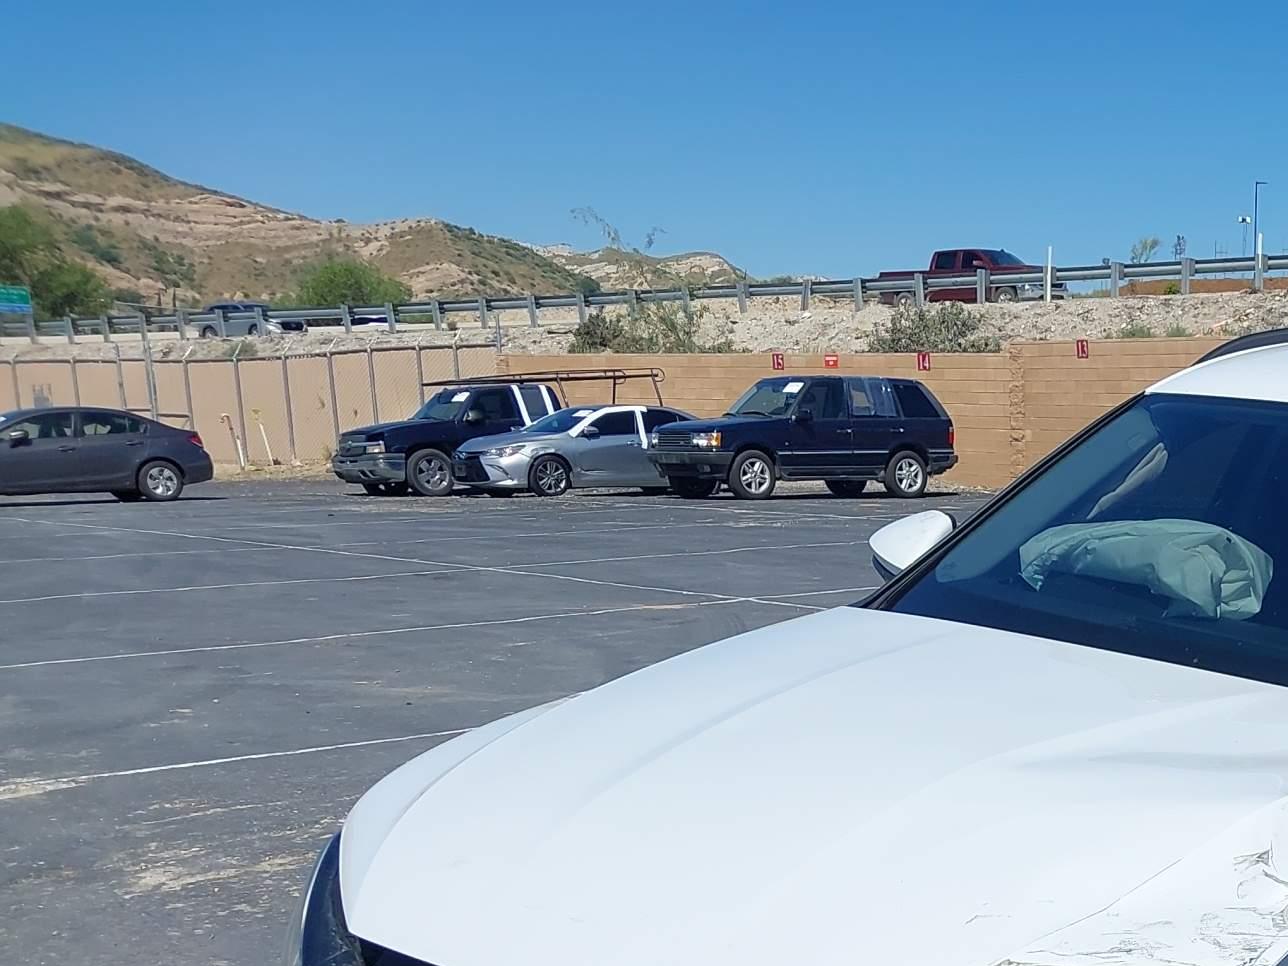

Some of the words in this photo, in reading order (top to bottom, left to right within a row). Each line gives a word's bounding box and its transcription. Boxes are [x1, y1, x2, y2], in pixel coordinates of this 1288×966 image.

[1078, 341, 1088, 357] 13
[773, 354, 783, 369] 15
[919, 354, 929, 370] 14
